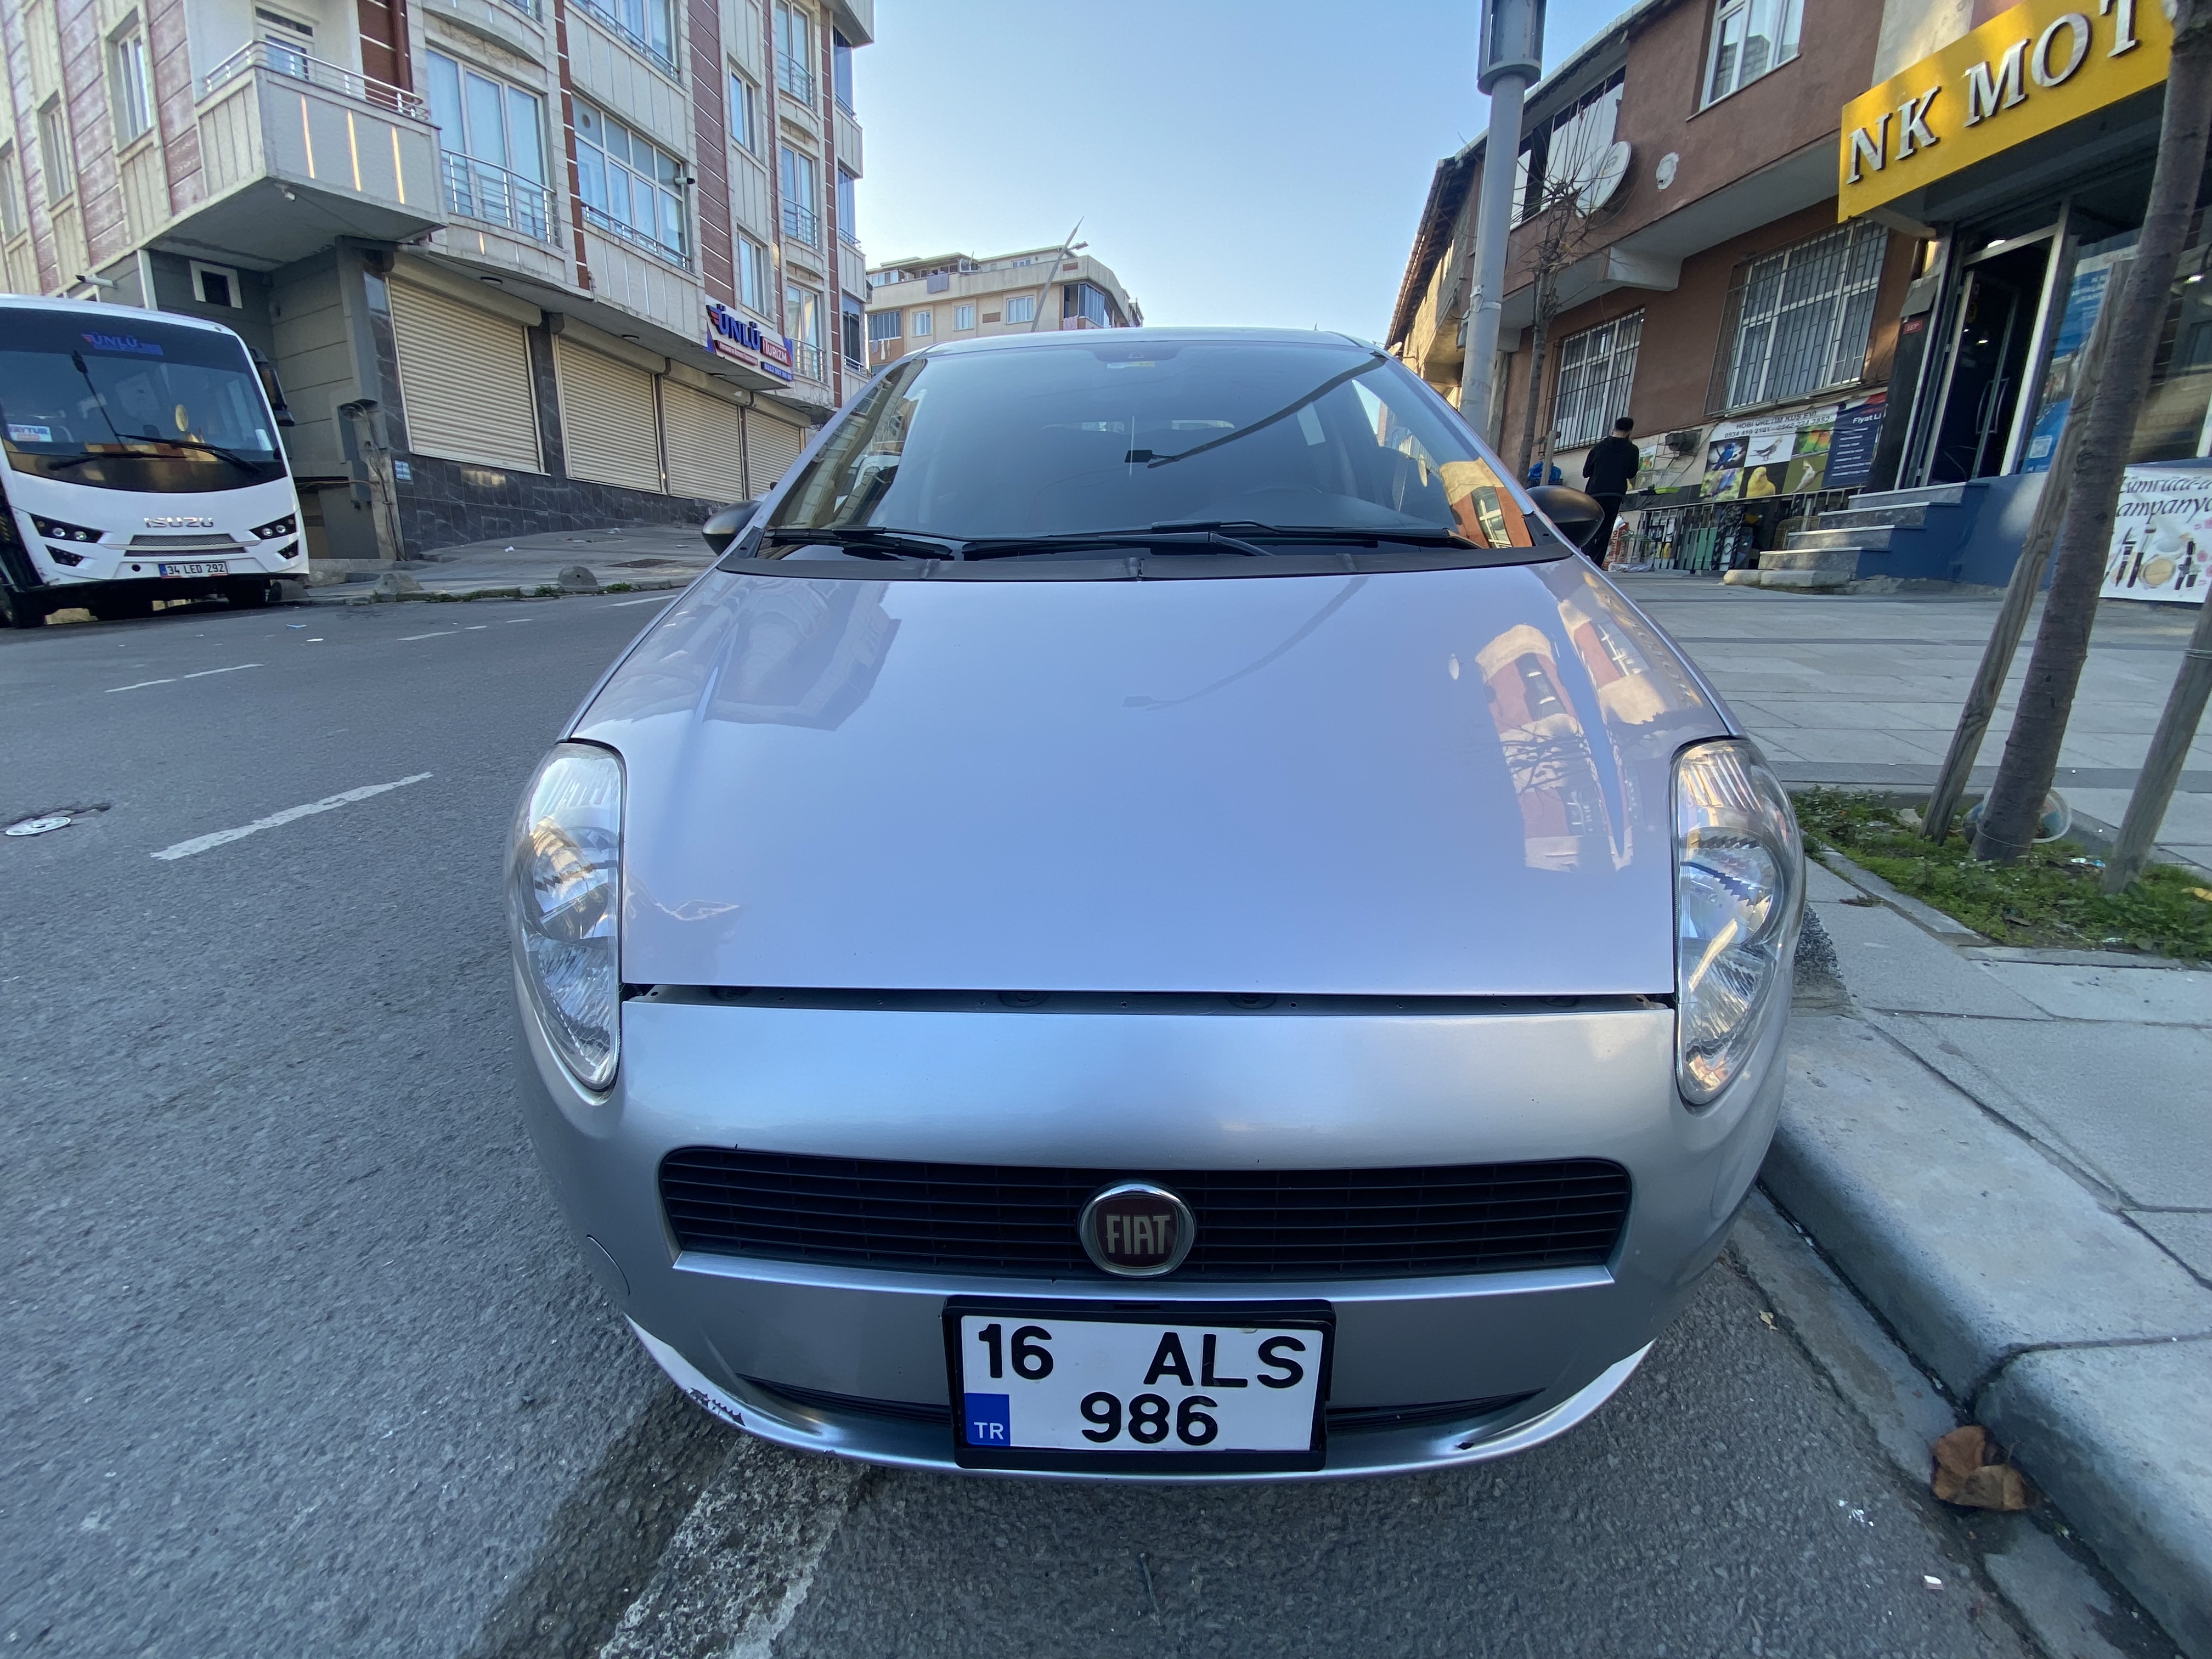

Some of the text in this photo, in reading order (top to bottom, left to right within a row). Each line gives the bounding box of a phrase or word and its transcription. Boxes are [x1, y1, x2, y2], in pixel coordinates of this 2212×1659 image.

[1847, 0, 2177, 184] NK MOT
[92, 331, 137, 348] ÜNLÜ
[714, 303, 761, 350] ÜNLÜ
[1853, 415, 1873, 424] Fiyat
[144, 517, 214, 528] ISUZU
[167, 566, 180, 574] 34
[183, 565, 202, 574] LED
[206, 563, 225, 573] 292
[1105, 1214, 1172, 1255] FIAT
[978, 1323, 1307, 1389] 16 ALS
[974, 1421, 1004, 1440] TR
[1080, 1391, 1218, 1446] 986
